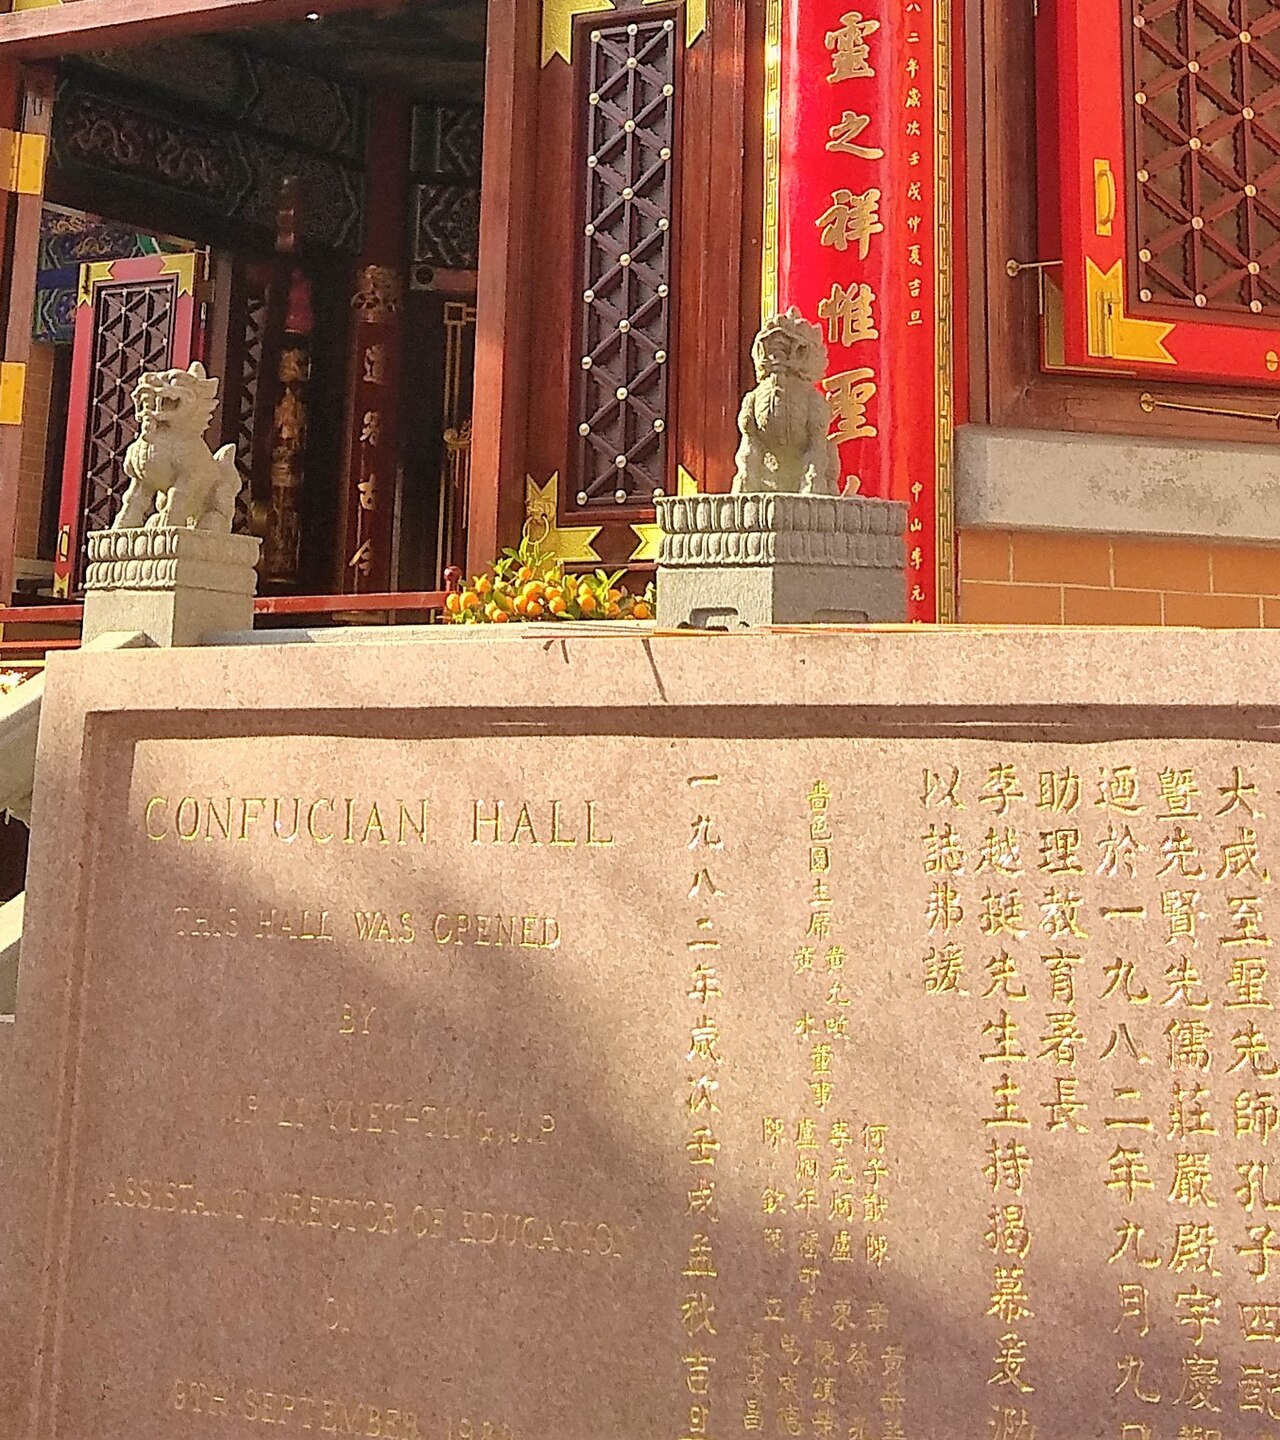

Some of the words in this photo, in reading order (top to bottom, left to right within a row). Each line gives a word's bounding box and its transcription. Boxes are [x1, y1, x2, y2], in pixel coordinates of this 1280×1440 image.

[143, 795, 429, 846] CONFUCIAN
[470, 798, 617, 850] HALL
[255, 907, 334, 943] HALL
[352, 910, 418, 946] WAS
[431, 911, 563, 951] OPENED
[338, 1001, 378, 1036] BY
